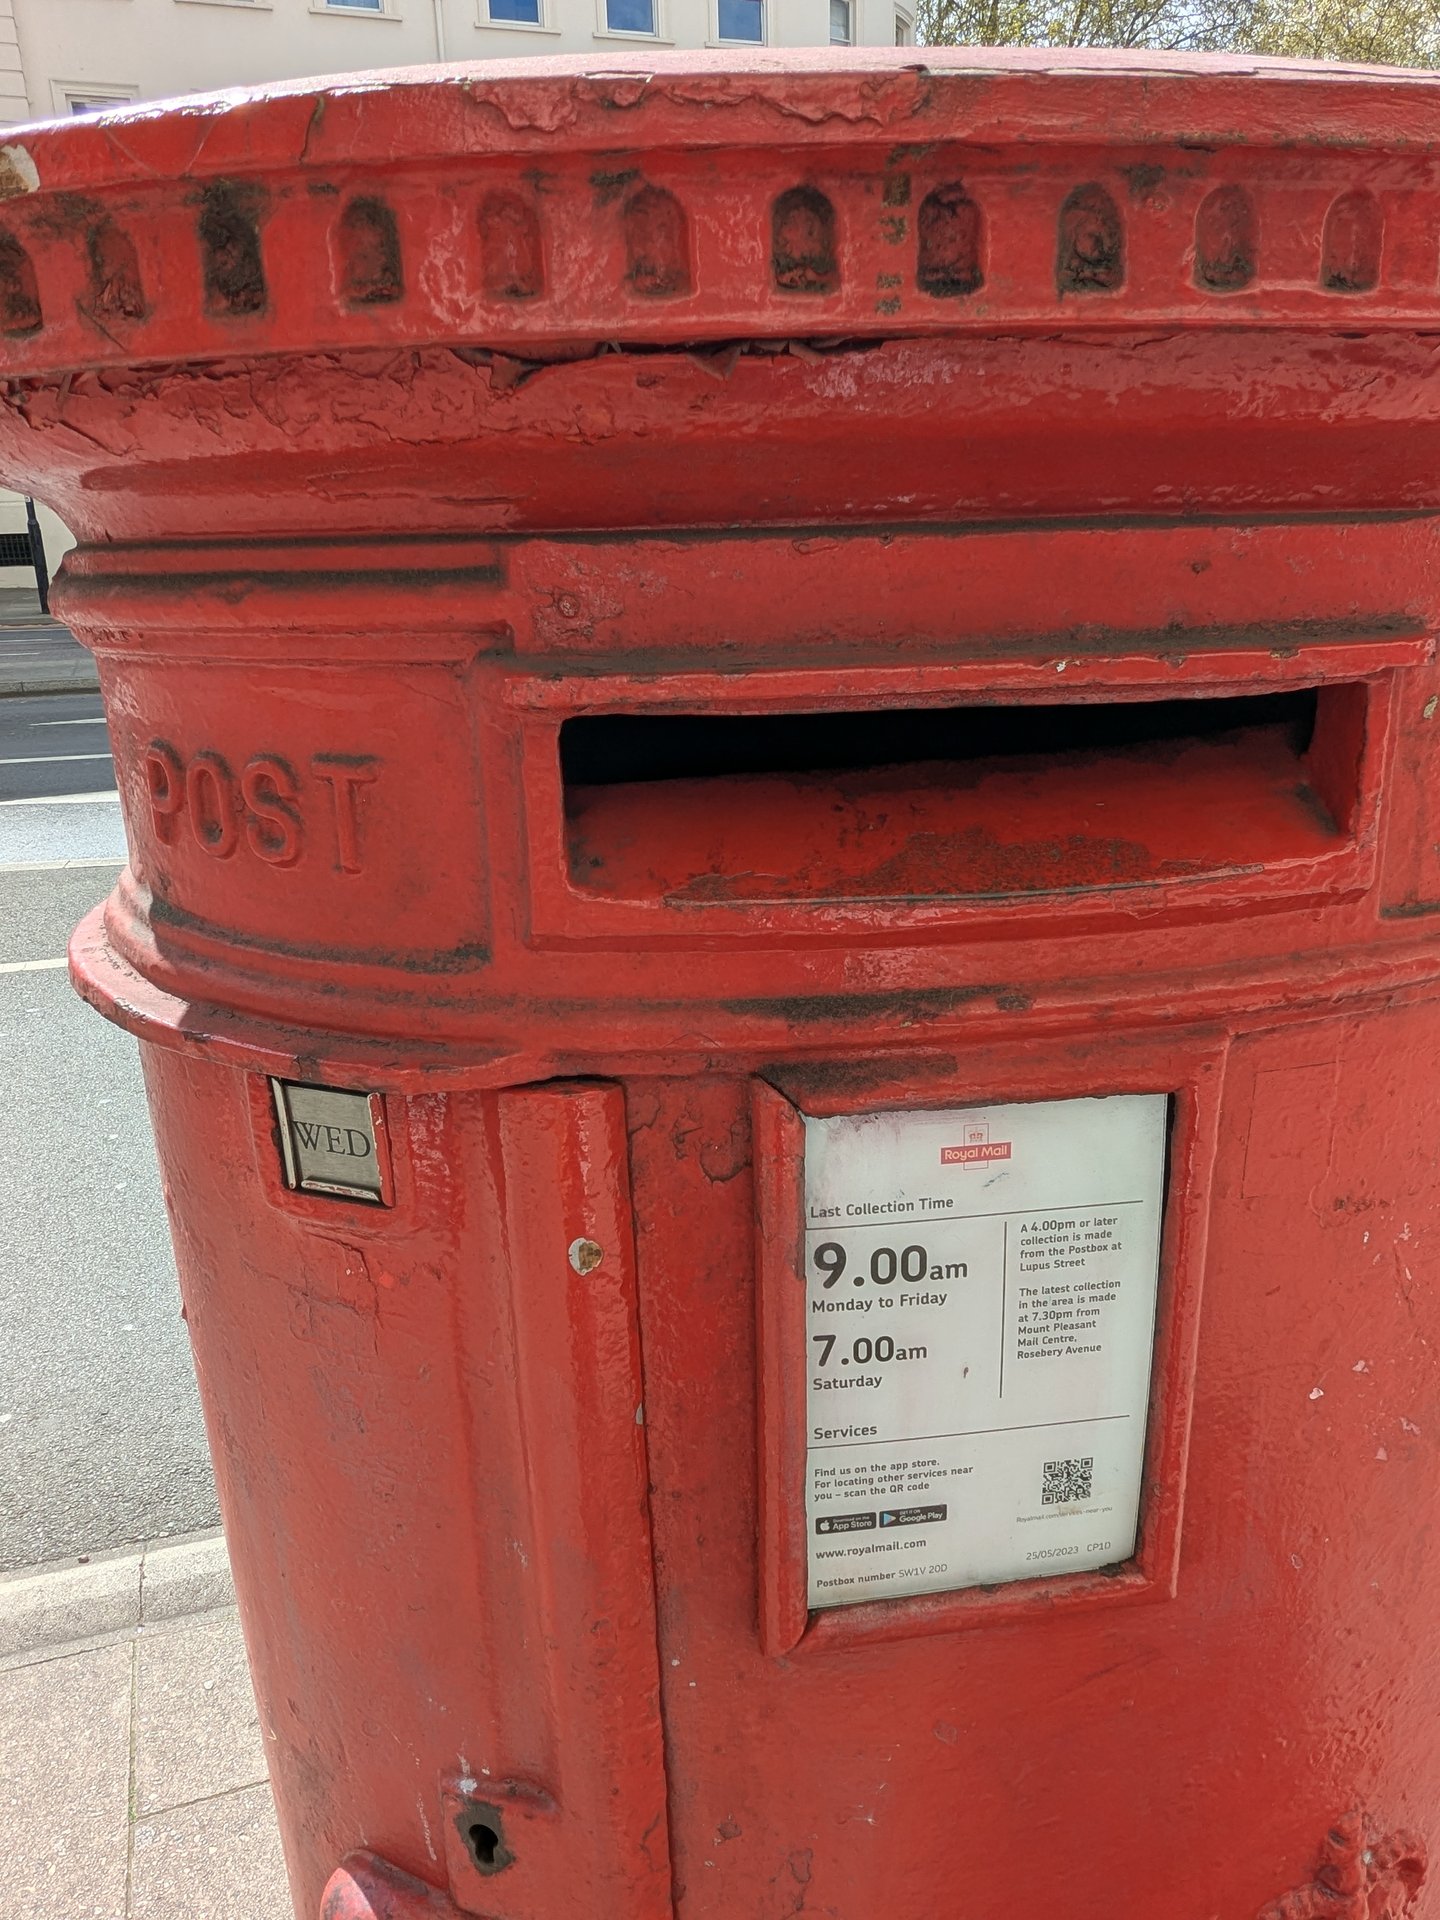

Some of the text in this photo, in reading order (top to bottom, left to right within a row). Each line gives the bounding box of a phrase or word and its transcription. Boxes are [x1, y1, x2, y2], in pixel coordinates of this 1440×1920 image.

[147, 740, 381, 875] POST
[292, 1121, 371, 1158] WED
[944, 1144, 1008, 1161] Royal Mail
[810, 1197, 954, 1218] Last Collection Time
[1020, 1217, 1118, 1233] A 4.00pm or later
[1020, 1229, 1112, 1246] collection is made
[1020, 1241, 1122, 1259] from the Postbox at
[813, 1242, 968, 1289] 9.00am
[1020, 1258, 1086, 1272] Lupus Street
[1019, 1280, 1121, 1297] The latest collection
[812, 1292, 947, 1313] Monday to Friday
[1018, 1292, 1117, 1309] in the area is made
[1018, 1307, 1100, 1323] at 7.30pm from
[1018, 1319, 1097, 1335] Mount Pleasant
[1017, 1334, 1077, 1347] Mail Centre,
[812, 1334, 928, 1368] 7.00am
[1017, 1343, 1102, 1360] Rosebery Avenue
[813, 1374, 883, 1391] Saturday
[814, 1425, 877, 1440] Services
[814, 1468, 836, 1477] Find
[870, 1464, 887, 1473] the
[890, 1462, 909, 1472] app
[911, 1458, 940, 1469] store.
[814, 1466, 974, 1489] For locating other services near
[814, 1492, 832, 1502] you
[843, 1489, 867, 1498] scan
[870, 1486, 887, 1496] the
[889, 1484, 904, 1493] QR
[907, 1482, 930, 1492] code
[832, 1522, 850, 1531] App
[850, 1519, 873, 1529] Store
[899, 1511, 943, 1523] Google Play
[816, 1540, 927, 1559] www.royalmail.com
[1026, 1546, 1079, 1561] 25/05/2023
[816, 1576, 855, 1588] Postbox
[857, 1571, 896, 1583] number
[898, 1566, 926, 1578] SW1V
